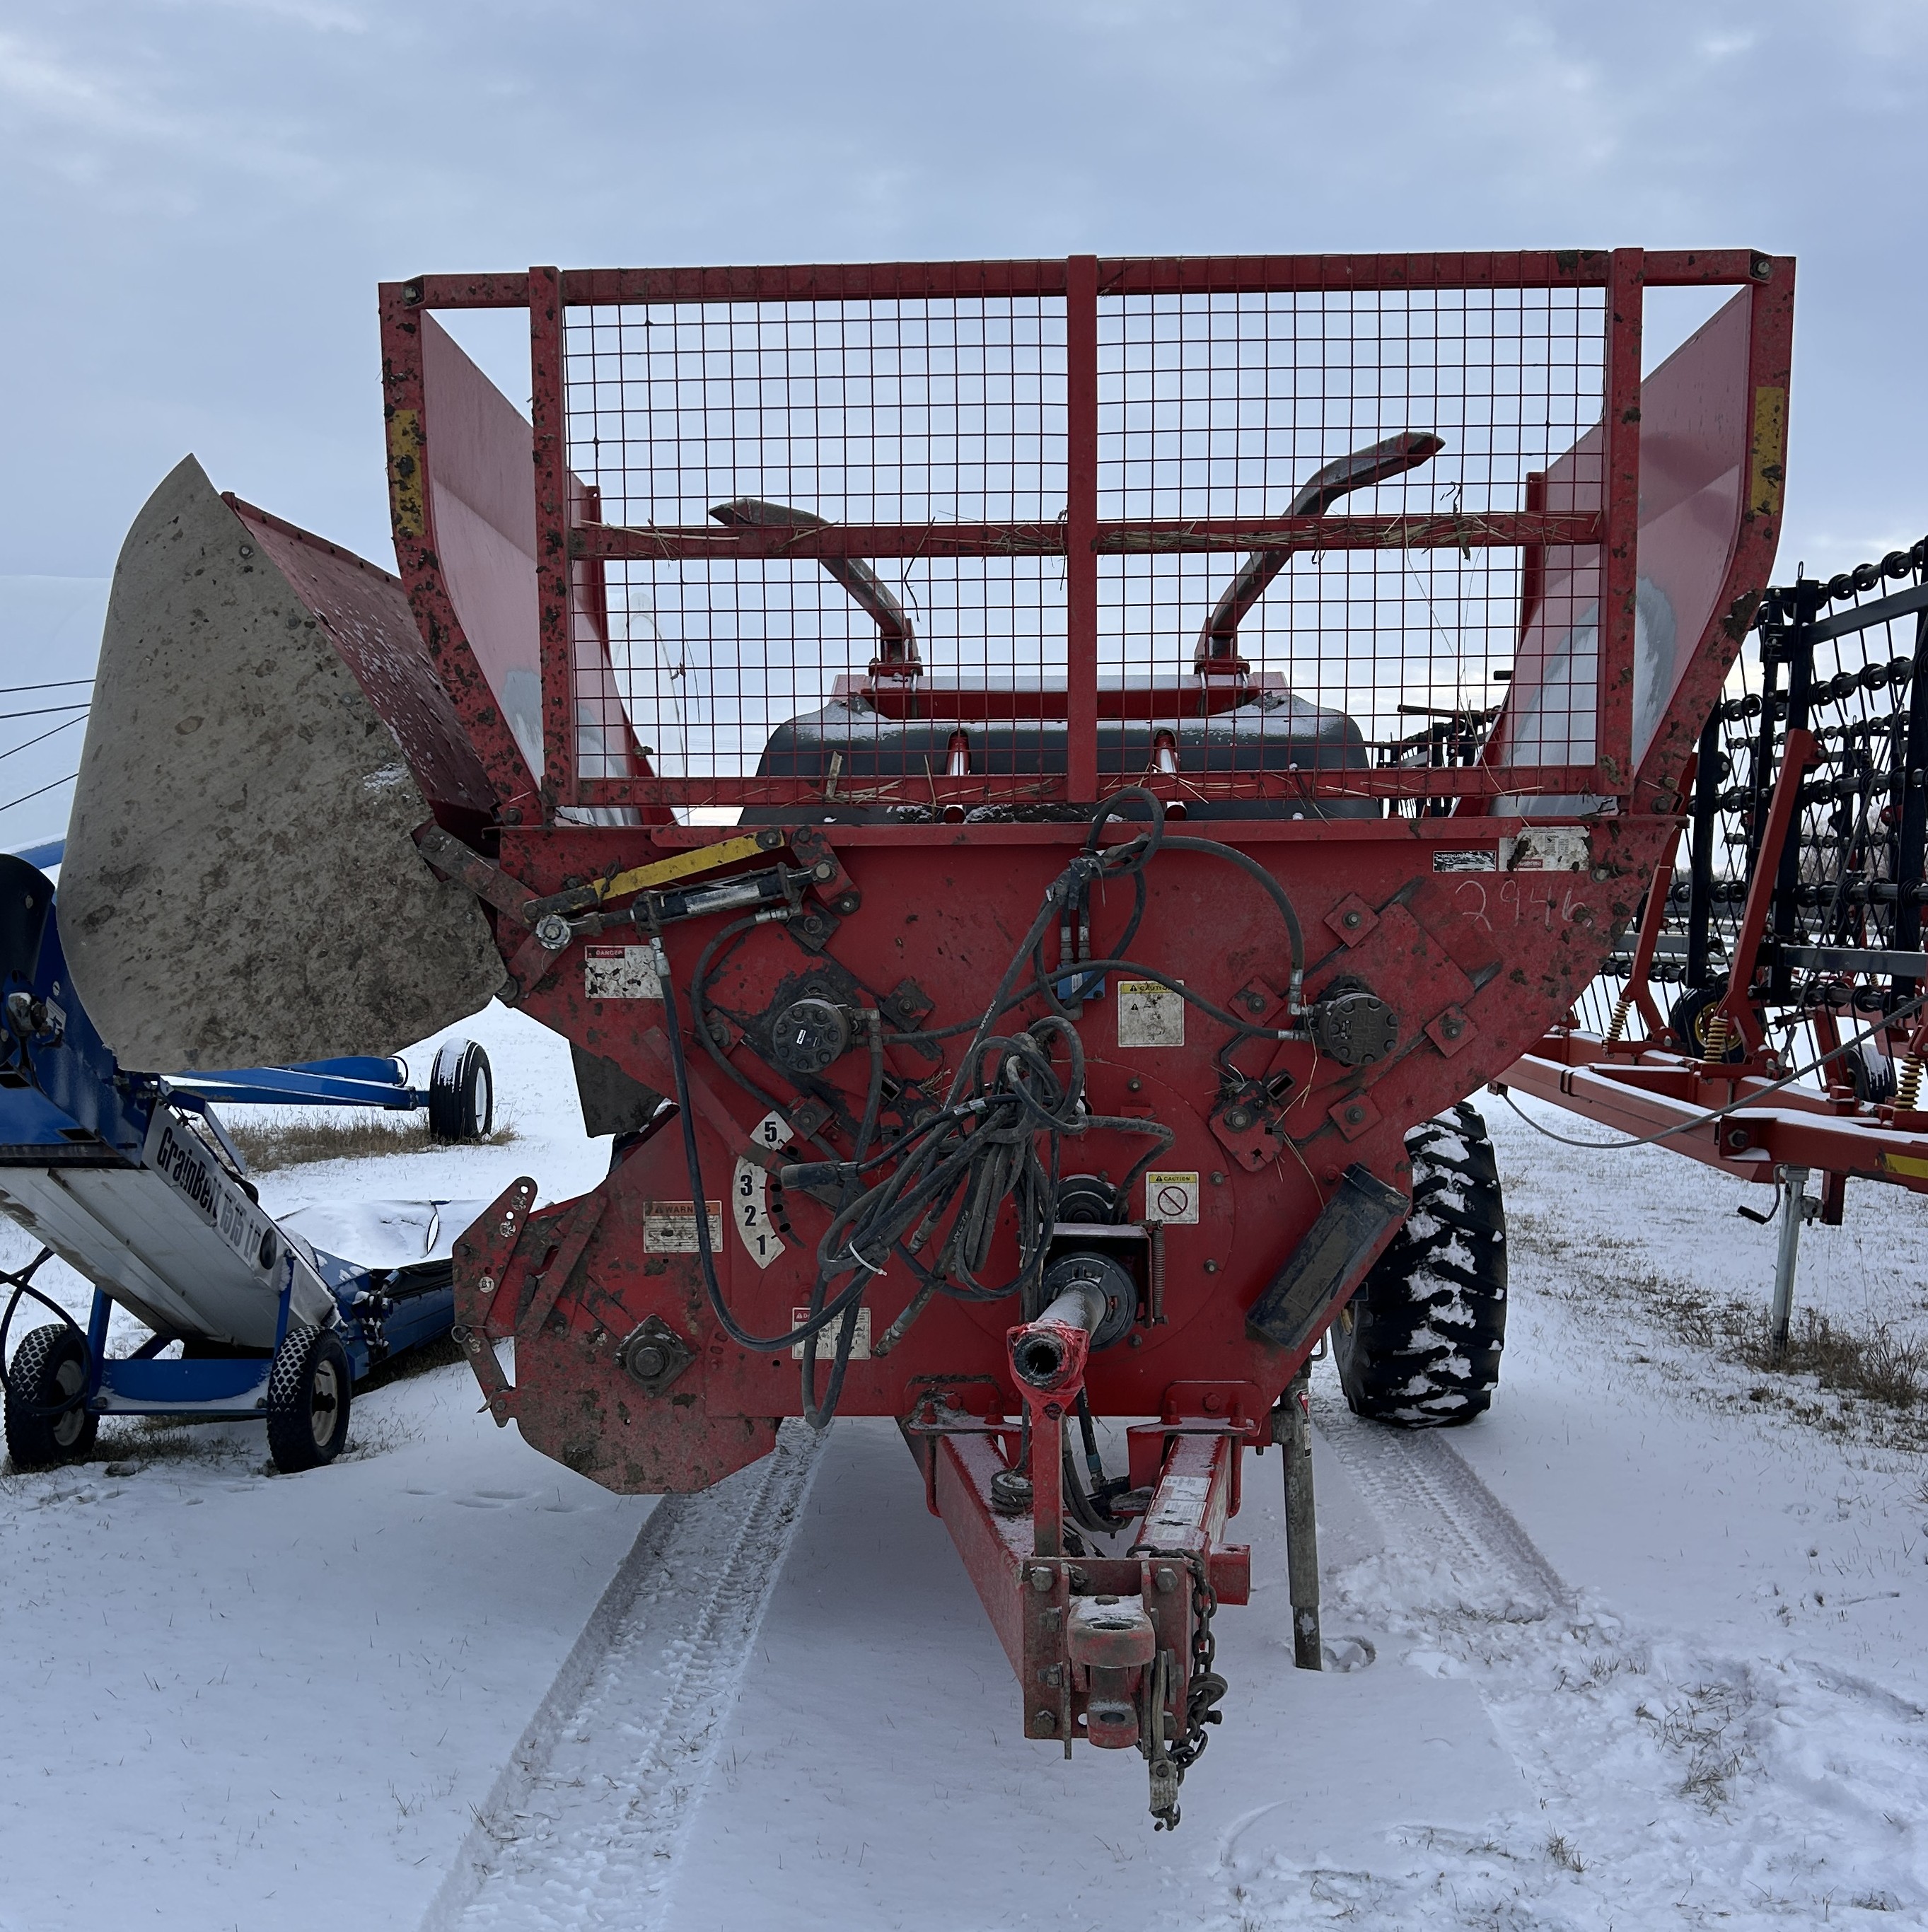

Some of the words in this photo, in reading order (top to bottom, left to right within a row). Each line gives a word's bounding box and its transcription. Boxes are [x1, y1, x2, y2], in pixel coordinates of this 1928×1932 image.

[1455, 880, 1593, 931] 2946
[765, 1122, 777, 1142] 5
[741, 1175, 753, 1196] 3
[666, 1205, 712, 1214] WARNG
[745, 1205, 756, 1226] 2
[756, 1235, 765, 1255] 1
[481, 1279, 493, 1288] B1
